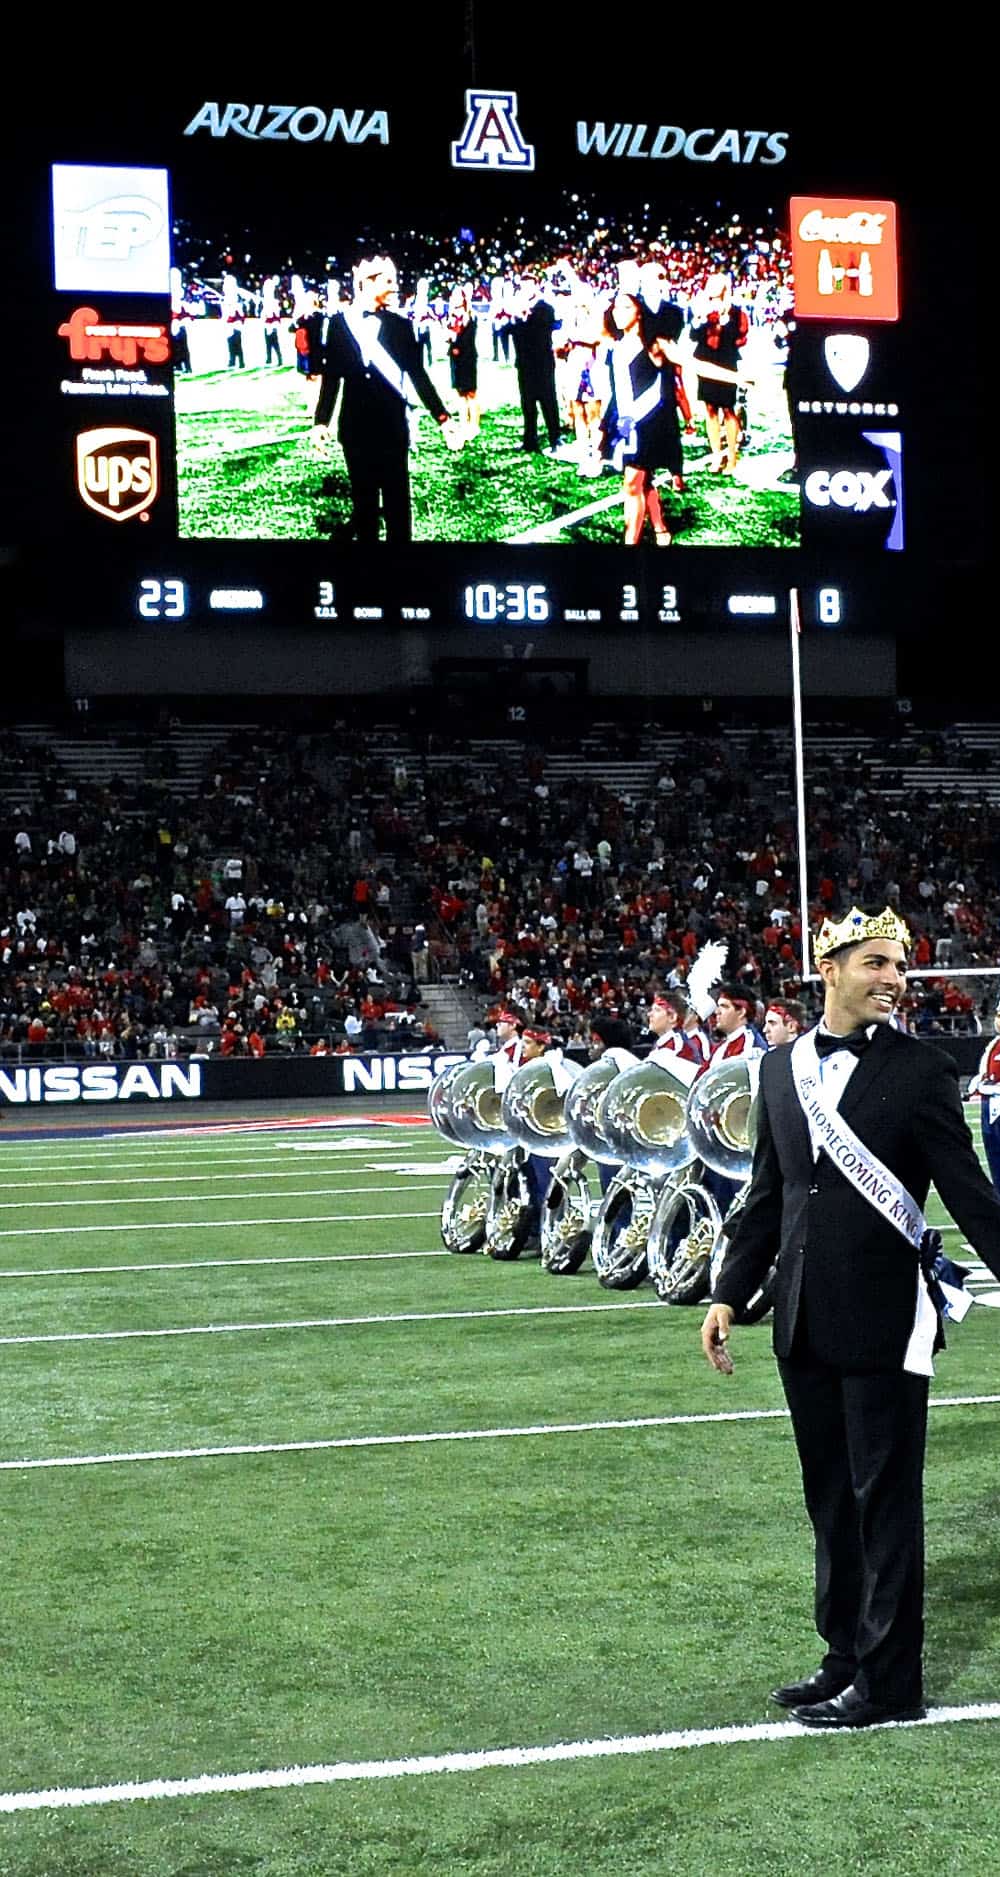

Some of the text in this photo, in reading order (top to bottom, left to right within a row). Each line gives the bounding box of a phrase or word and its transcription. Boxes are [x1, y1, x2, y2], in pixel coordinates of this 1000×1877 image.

[184, 101, 389, 145] ARIZONA
[576, 120, 789, 164] WILDCATS
[84, 456, 151, 506] ups
[139, 580, 185, 616] 23
[320, 582, 333, 605] 3
[465, 584, 548, 620] 10:36
[622, 585, 636, 608] 3
[663, 586, 676, 608] 3
[819, 588, 840, 623] 8
[509, 706, 525, 721] 12
[897, 701, 912, 713] 13
[0, 1063, 201, 1102] NISSAN
[808, 1101, 892, 1204] HOMECOMING
[889, 1200, 920, 1239] KING
